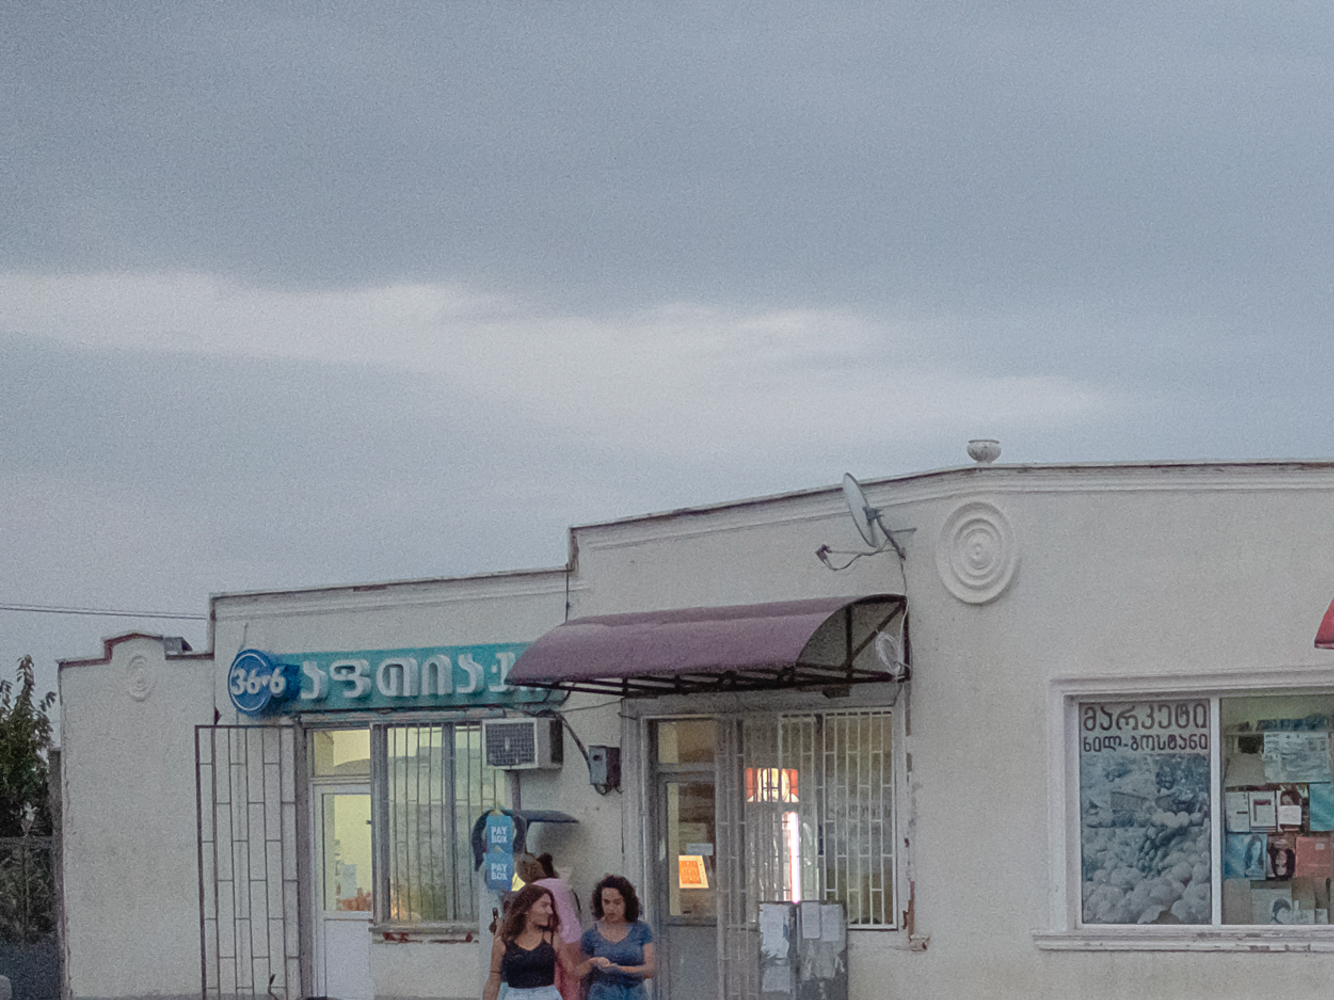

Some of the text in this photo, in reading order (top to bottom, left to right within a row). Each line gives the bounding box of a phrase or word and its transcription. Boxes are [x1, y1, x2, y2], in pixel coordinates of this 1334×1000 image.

[301, 652, 543, 699] აფთიაქ
[1083, 702, 1208, 731] მარკეტი
[1083, 734, 1208, 752] ხილ-ბოსტანი
[491, 826, 508, 835] PAY
